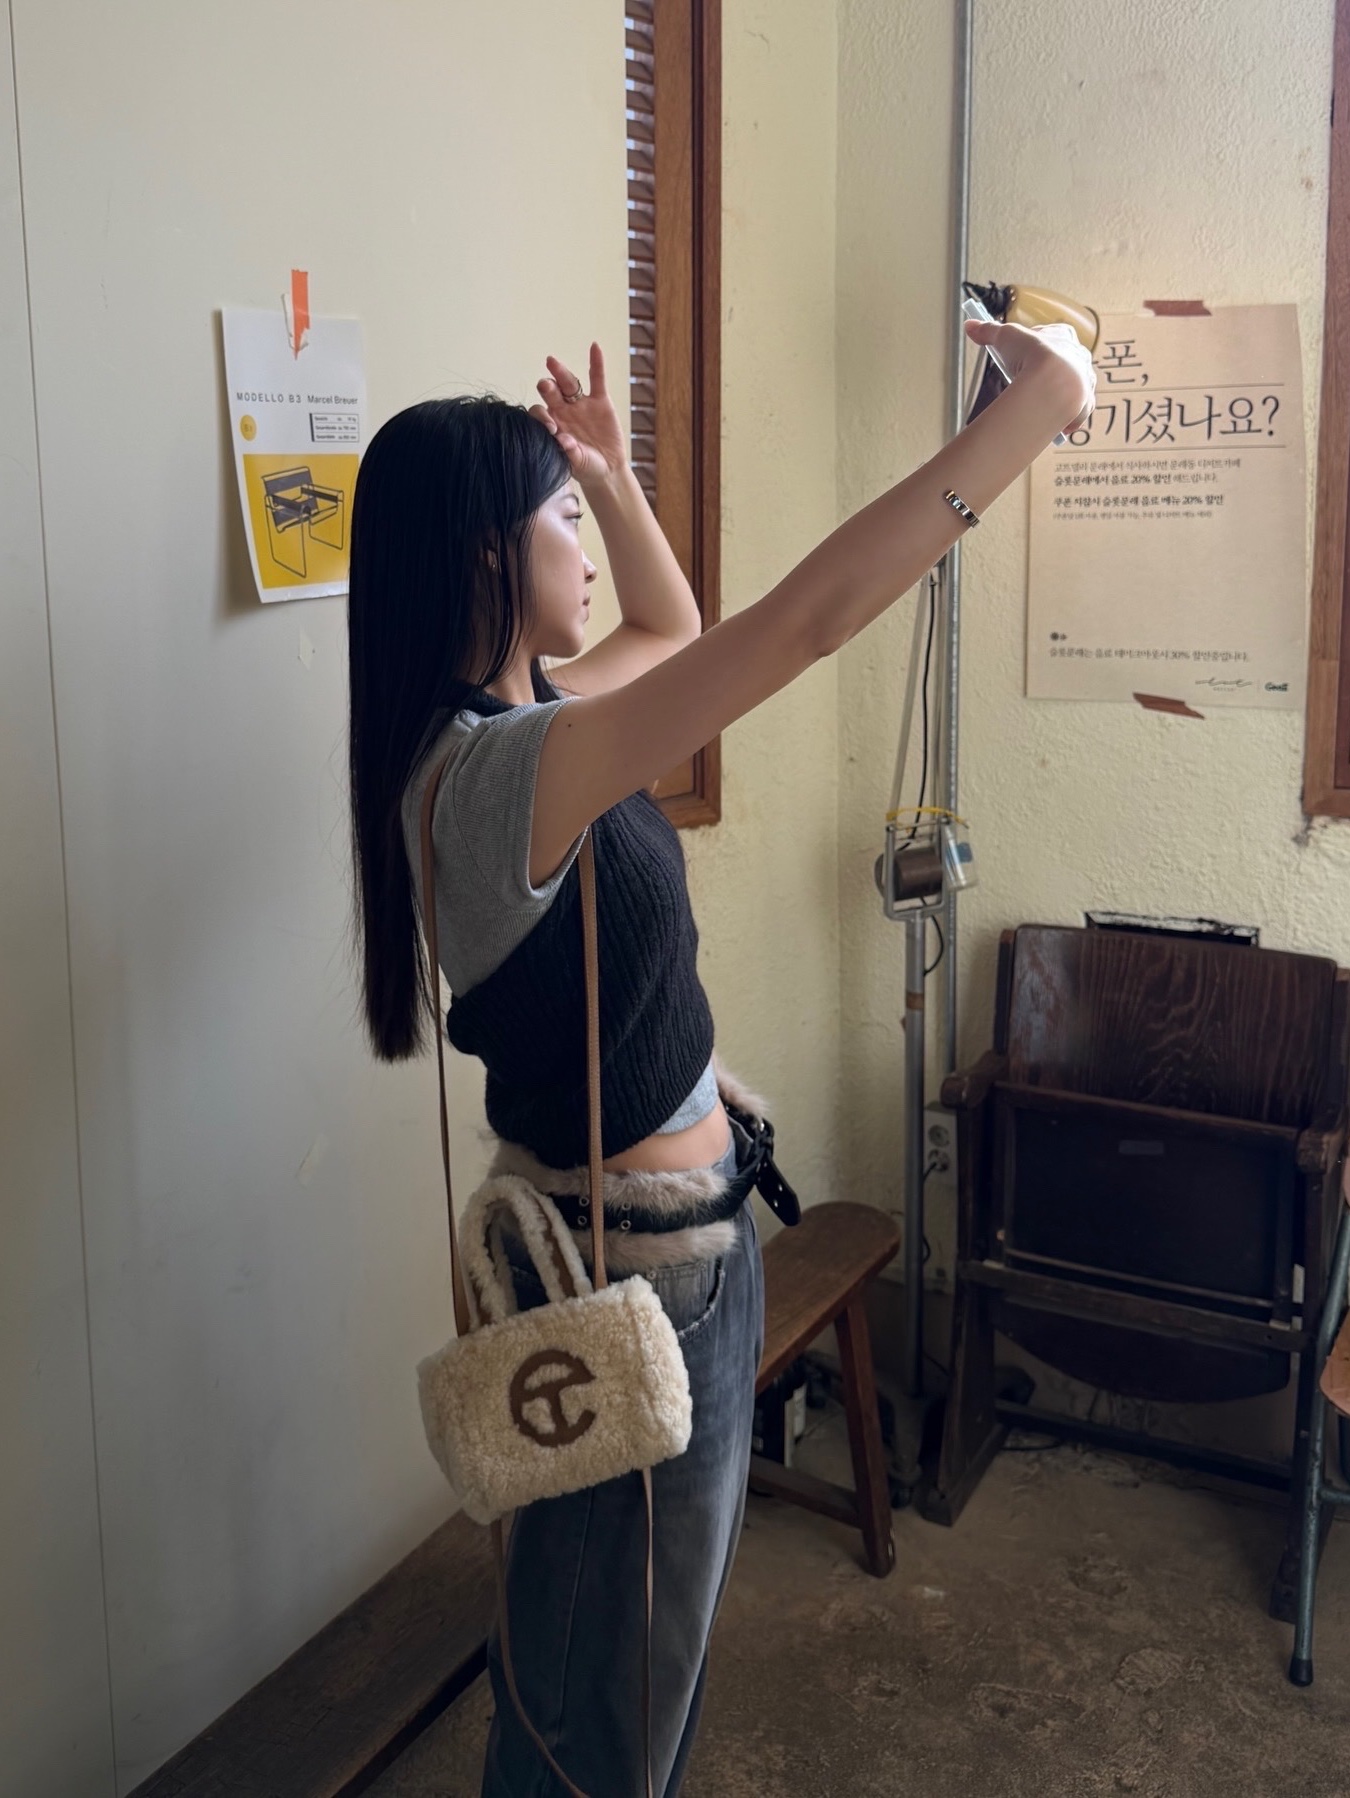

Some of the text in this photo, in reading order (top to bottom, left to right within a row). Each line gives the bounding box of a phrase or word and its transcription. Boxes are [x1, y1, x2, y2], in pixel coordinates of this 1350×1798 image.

[1092, 339, 1149, 386] 폰,
[236, 392, 359, 405] MODELLO B3 Marcel Breuer
[1170, 460, 1195, 470] 문래동
[1111, 475, 1129, 486] 음료
[1131, 474, 1151, 484] 20%
[1153, 473, 1171, 484] 할인
[1055, 496, 1072, 508] 쿠폰
[1141, 495, 1159, 507] 음료
[1160, 494, 1181, 506] 메뉴
[1182, 494, 1203, 505] 20%
[1204, 494, 1223, 505] 할인
